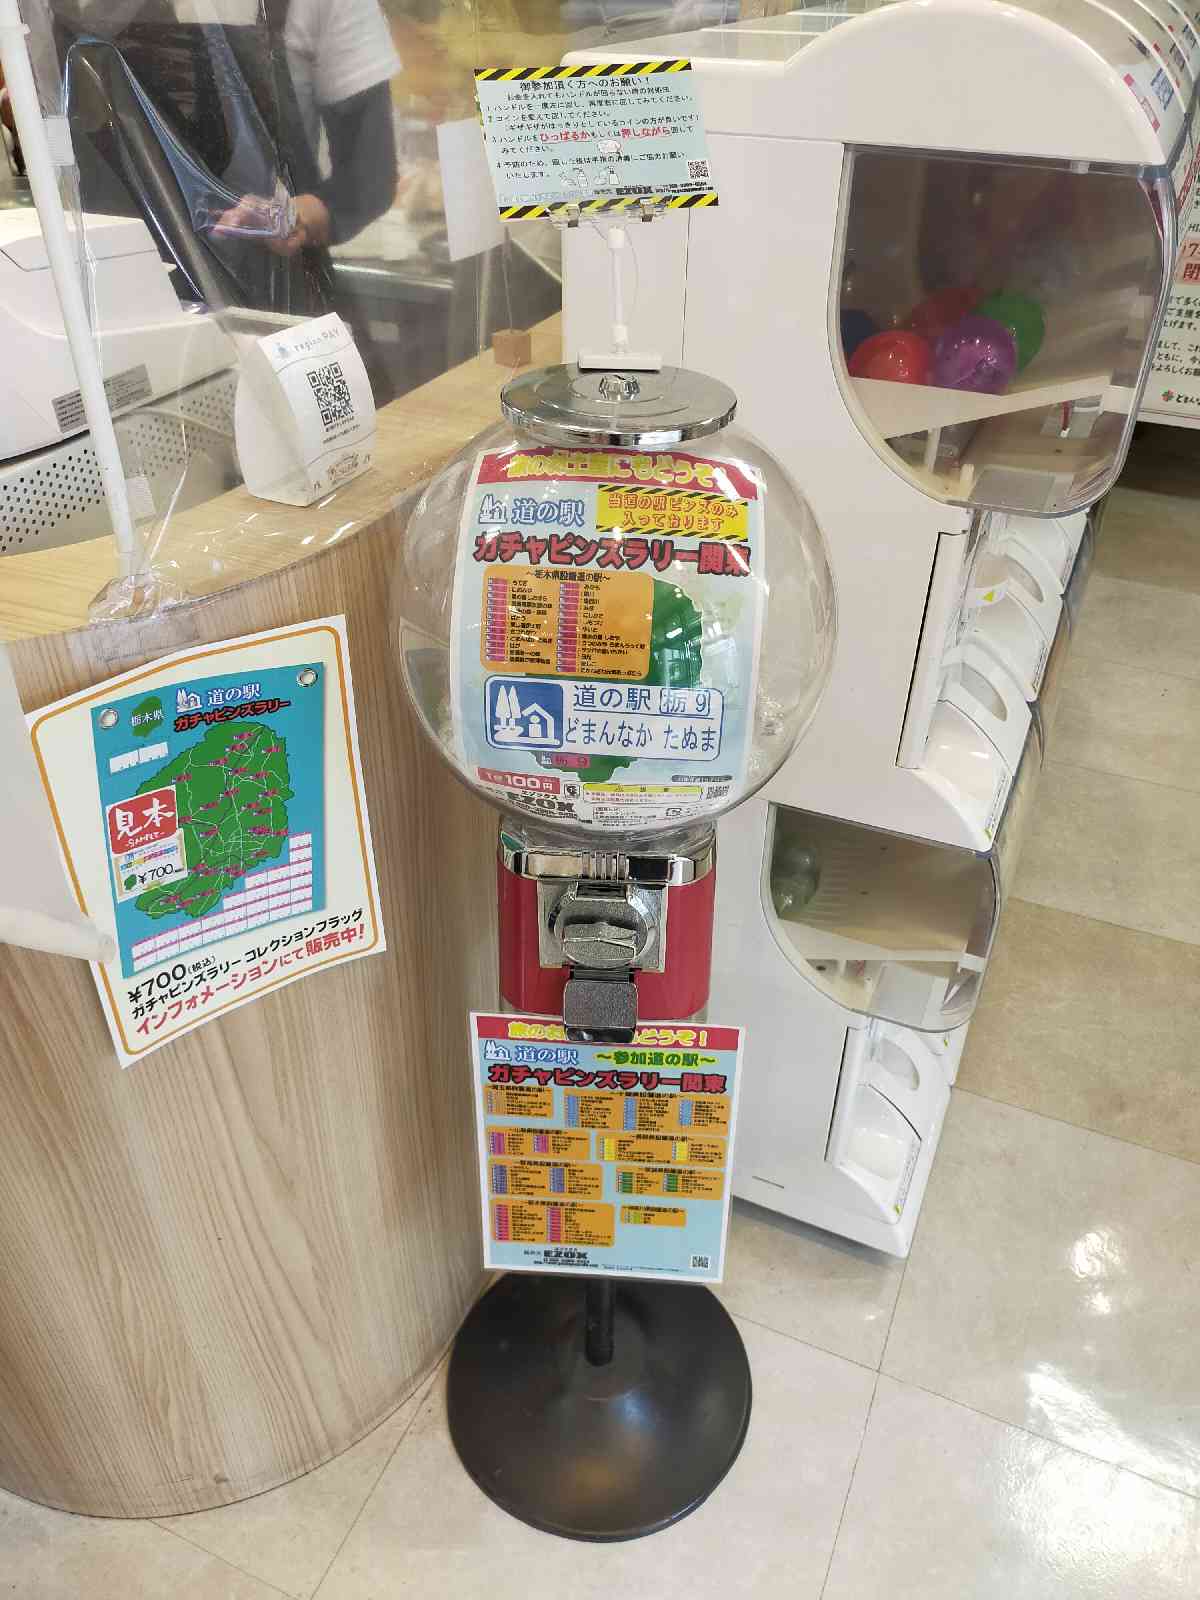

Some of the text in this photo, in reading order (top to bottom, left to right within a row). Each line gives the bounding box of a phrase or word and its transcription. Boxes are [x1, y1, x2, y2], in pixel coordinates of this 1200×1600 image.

[511, 498, 585, 526] 道の駅
[474, 530, 751, 577] ガチャピンズラリー関東
[208, 683, 261, 706] 道の駅
[573, 685, 707, 713] 道の駅 栃 9
[131, 709, 163, 727] 栃木県
[174, 698, 291, 732] ガチャピンズラリー
[565, 717, 717, 752] どまんなか たぬま
[114, 797, 175, 840] 見本
[131, 907, 363, 1019] ガチャピンズラリー コレクションフラッグ
[135, 923, 366, 1035] インフォメーションにて販売中！
[515, 1046, 578, 1065] 道の駅
[488, 1064, 728, 1094] ガチャピンズラリー関東
